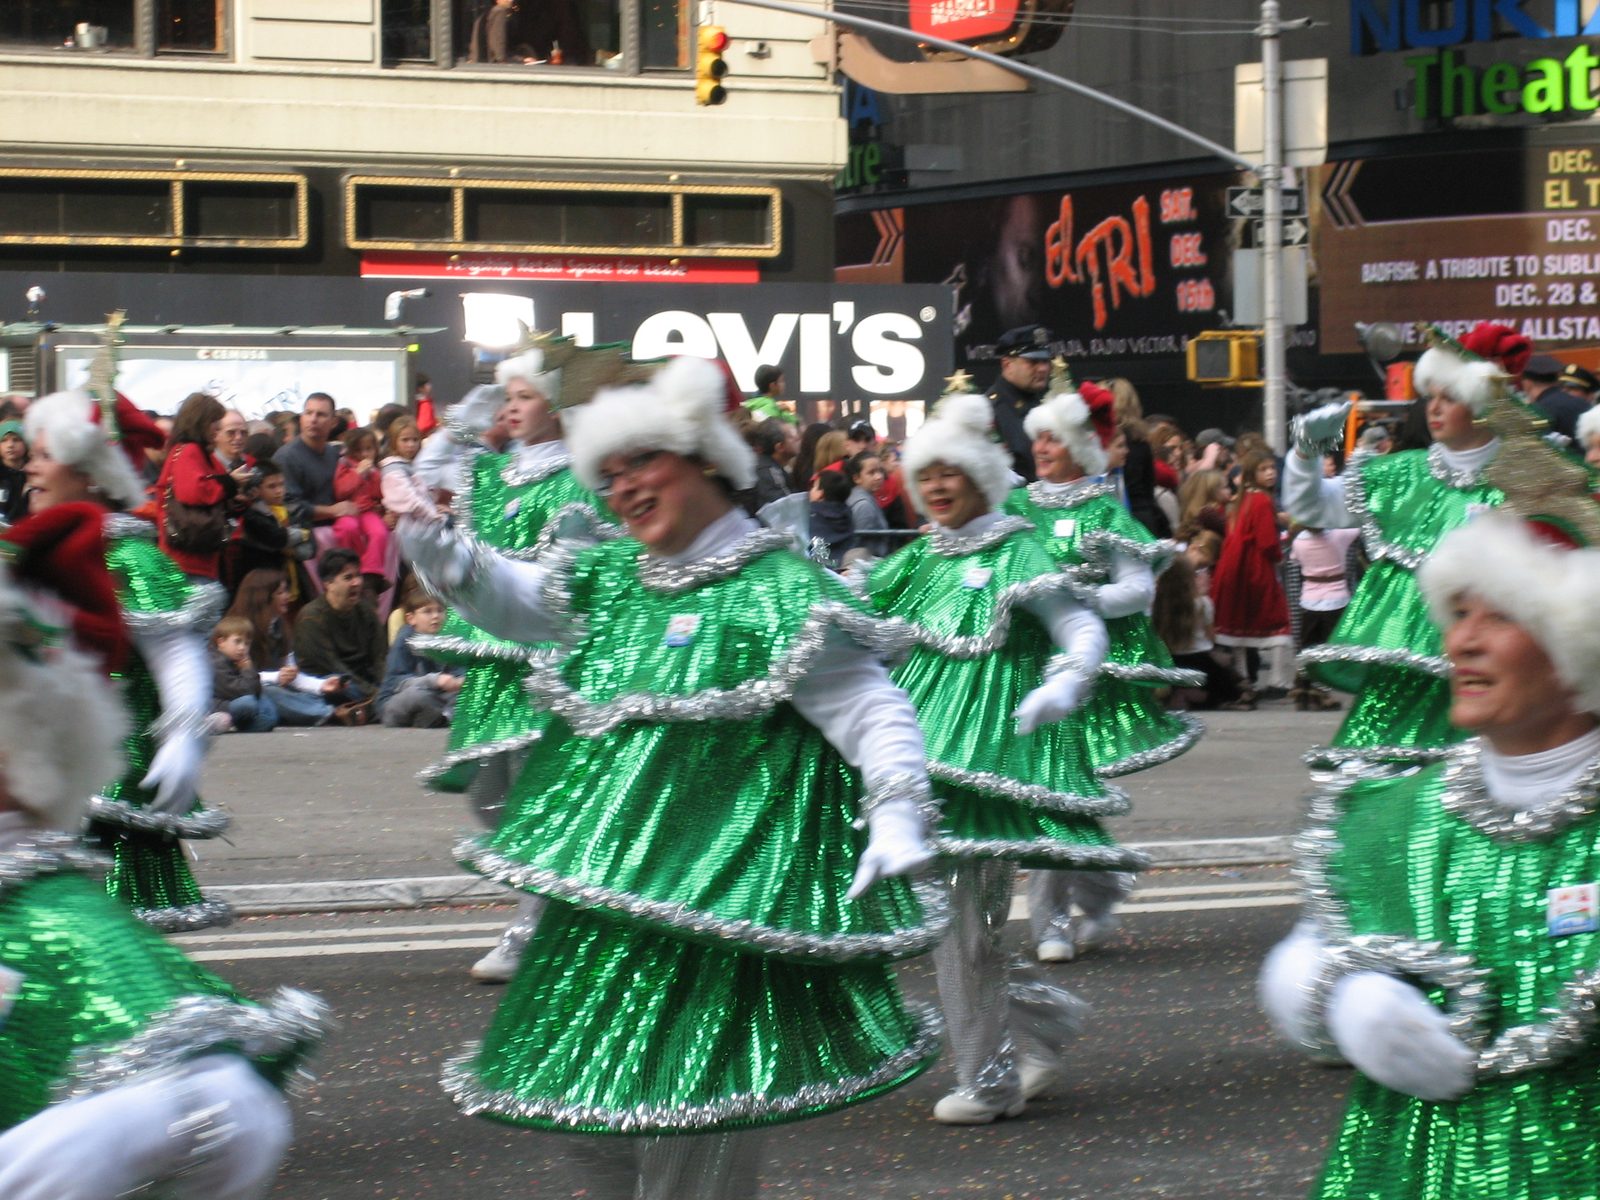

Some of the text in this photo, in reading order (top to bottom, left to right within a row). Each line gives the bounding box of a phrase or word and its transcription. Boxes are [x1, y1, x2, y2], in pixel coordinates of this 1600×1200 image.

[1548, 149, 1598, 174] DEC.
[1544, 179, 1578, 208] EL
[1546, 218, 1597, 243] DEC.
[1425, 260, 1438, 281] A
[1440, 256, 1512, 279] TRIBUTE
[1514, 255, 1539, 277] TO
[1496, 281, 1599, 307] DEC. 28 &
